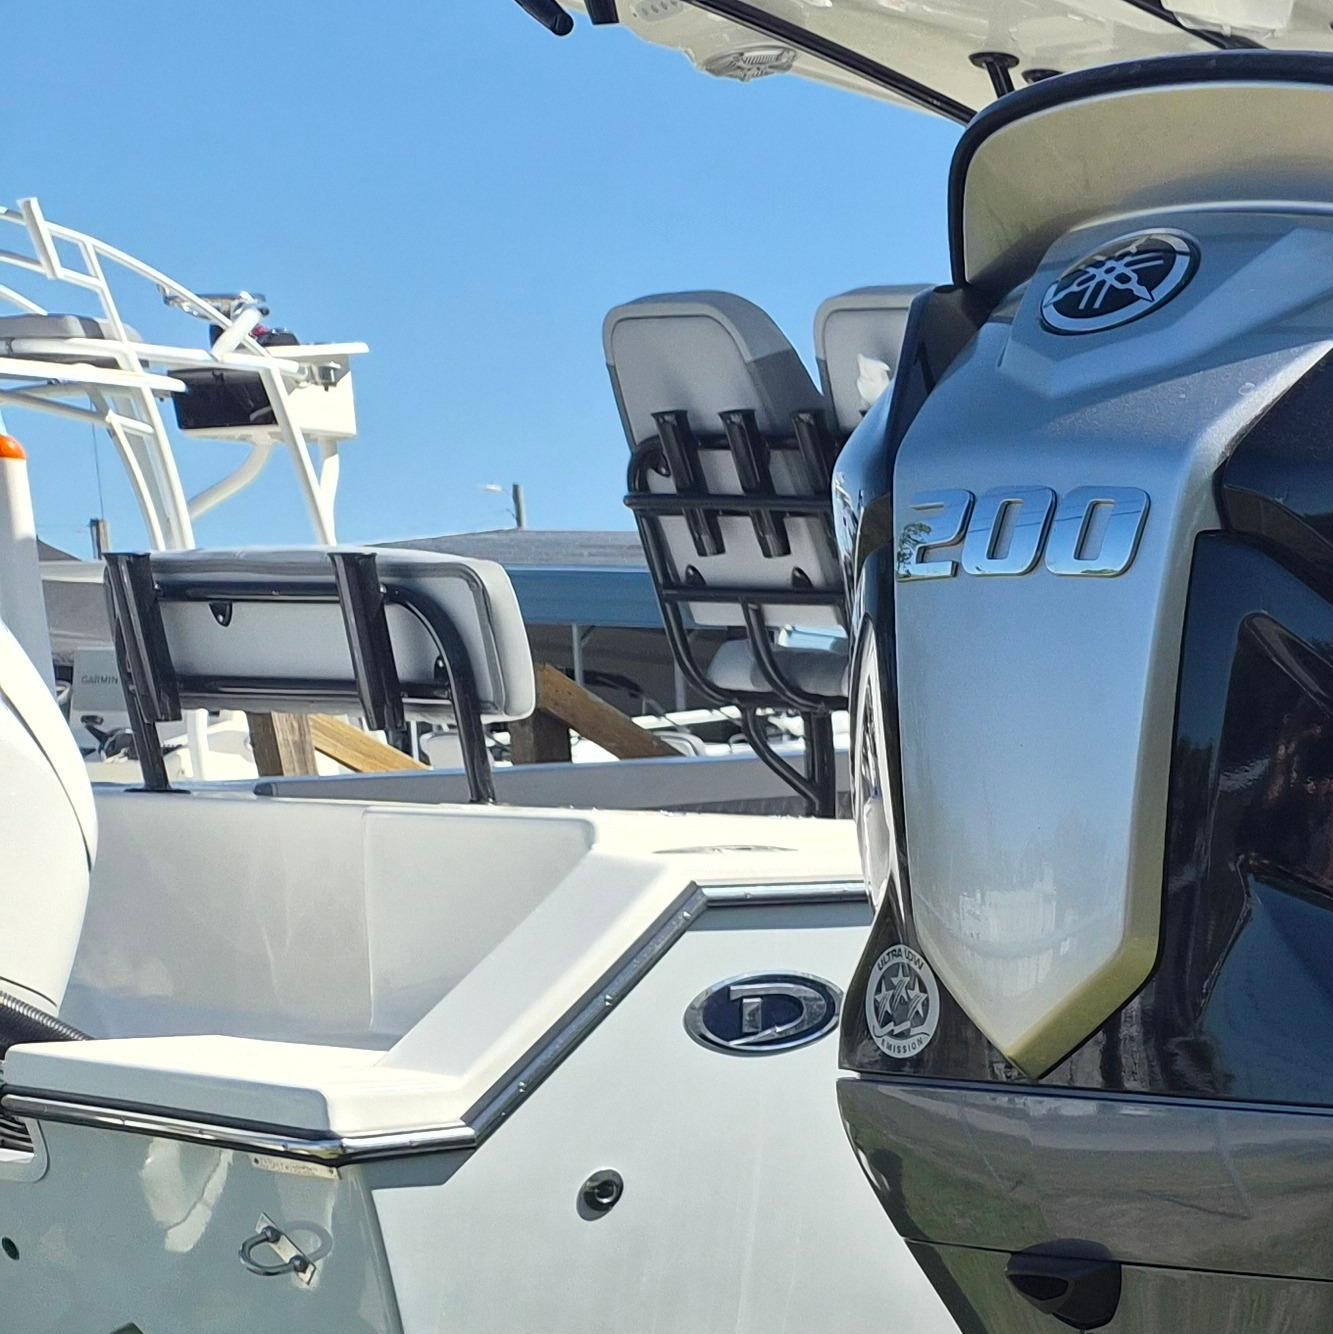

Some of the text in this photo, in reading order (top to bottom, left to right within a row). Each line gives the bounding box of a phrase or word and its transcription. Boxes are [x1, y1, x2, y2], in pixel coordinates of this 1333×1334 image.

[896, 485, 1151, 580] 200
[81, 675, 119, 686] GARMIN
[878, 949, 924, 971] ULTRA LOW
[880, 1037, 924, 1054] EMISSION
